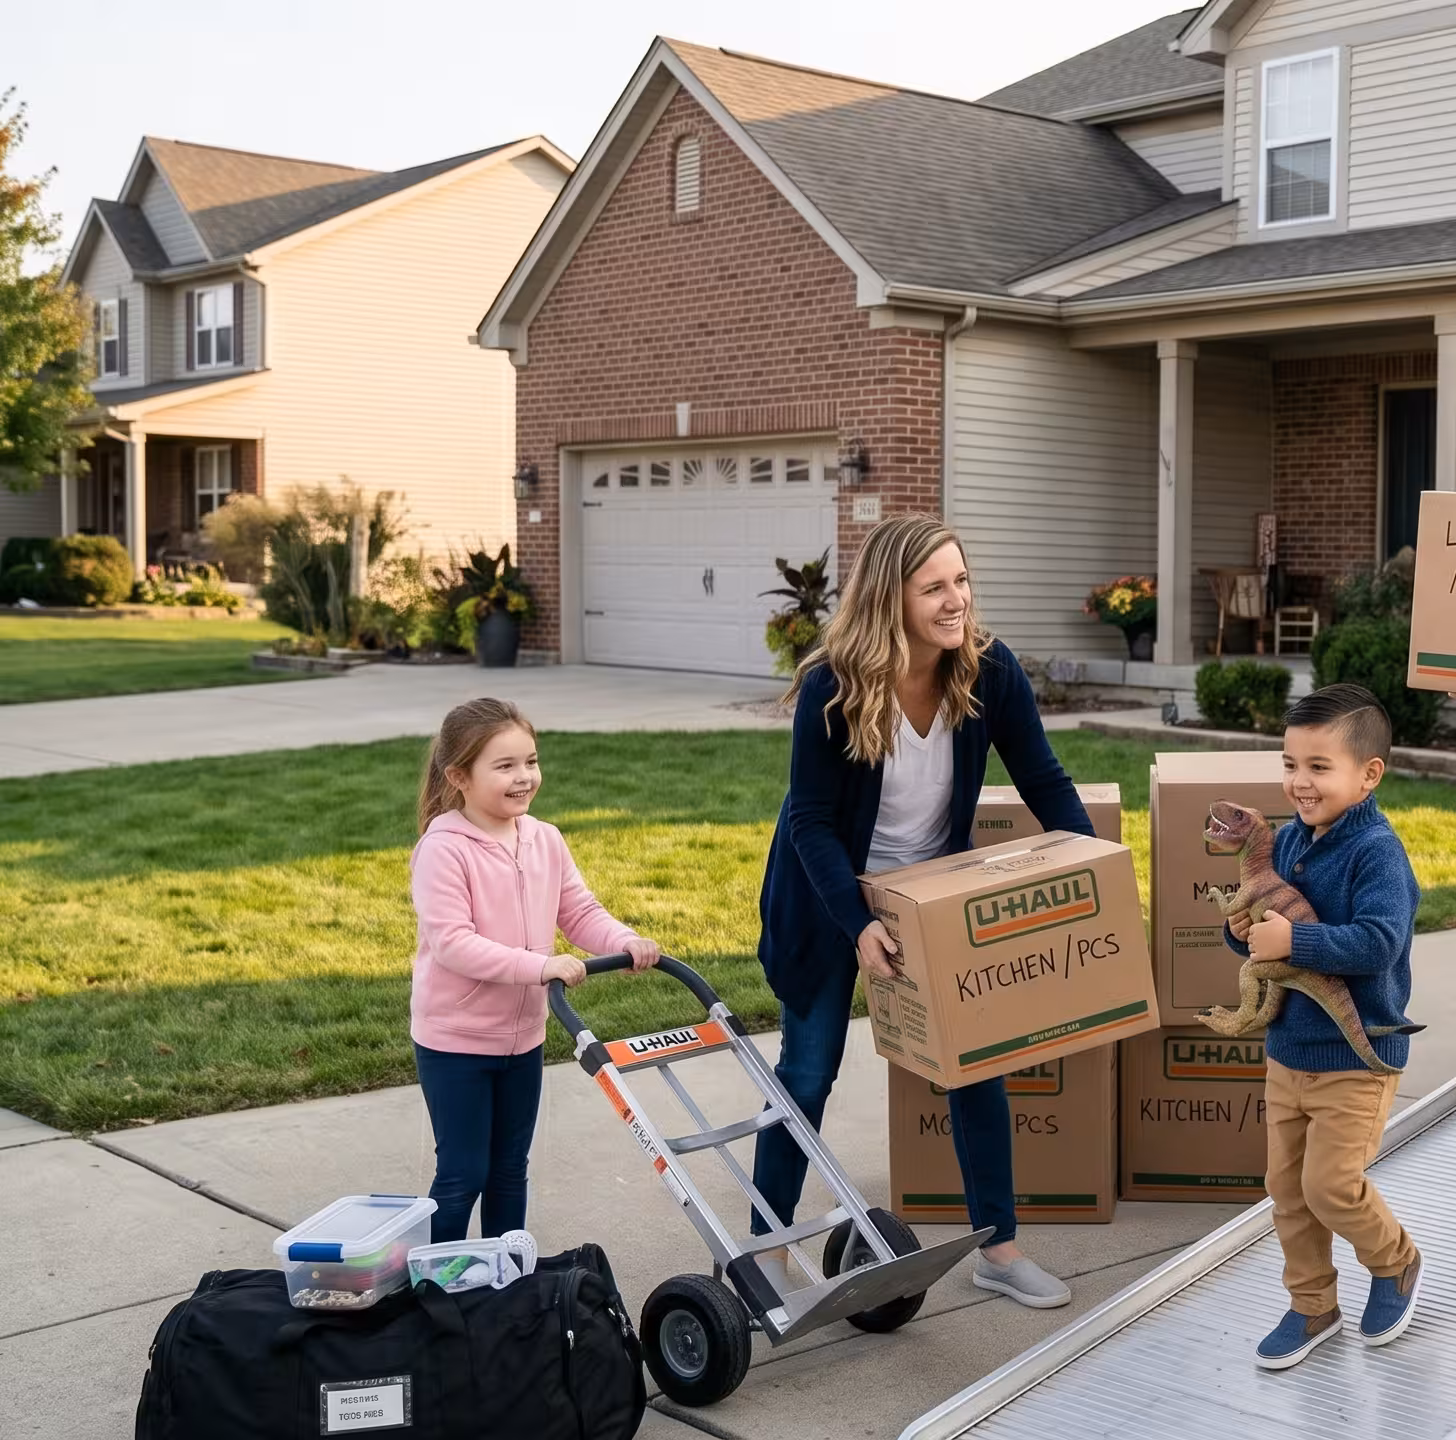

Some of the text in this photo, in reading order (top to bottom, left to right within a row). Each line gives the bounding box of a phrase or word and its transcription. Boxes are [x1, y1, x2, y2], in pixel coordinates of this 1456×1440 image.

[975, 879, 1090, 926] U-HAUL
[629, 1028, 700, 1054] U-HAUL
[1173, 1044, 1264, 1064] U-HAU
